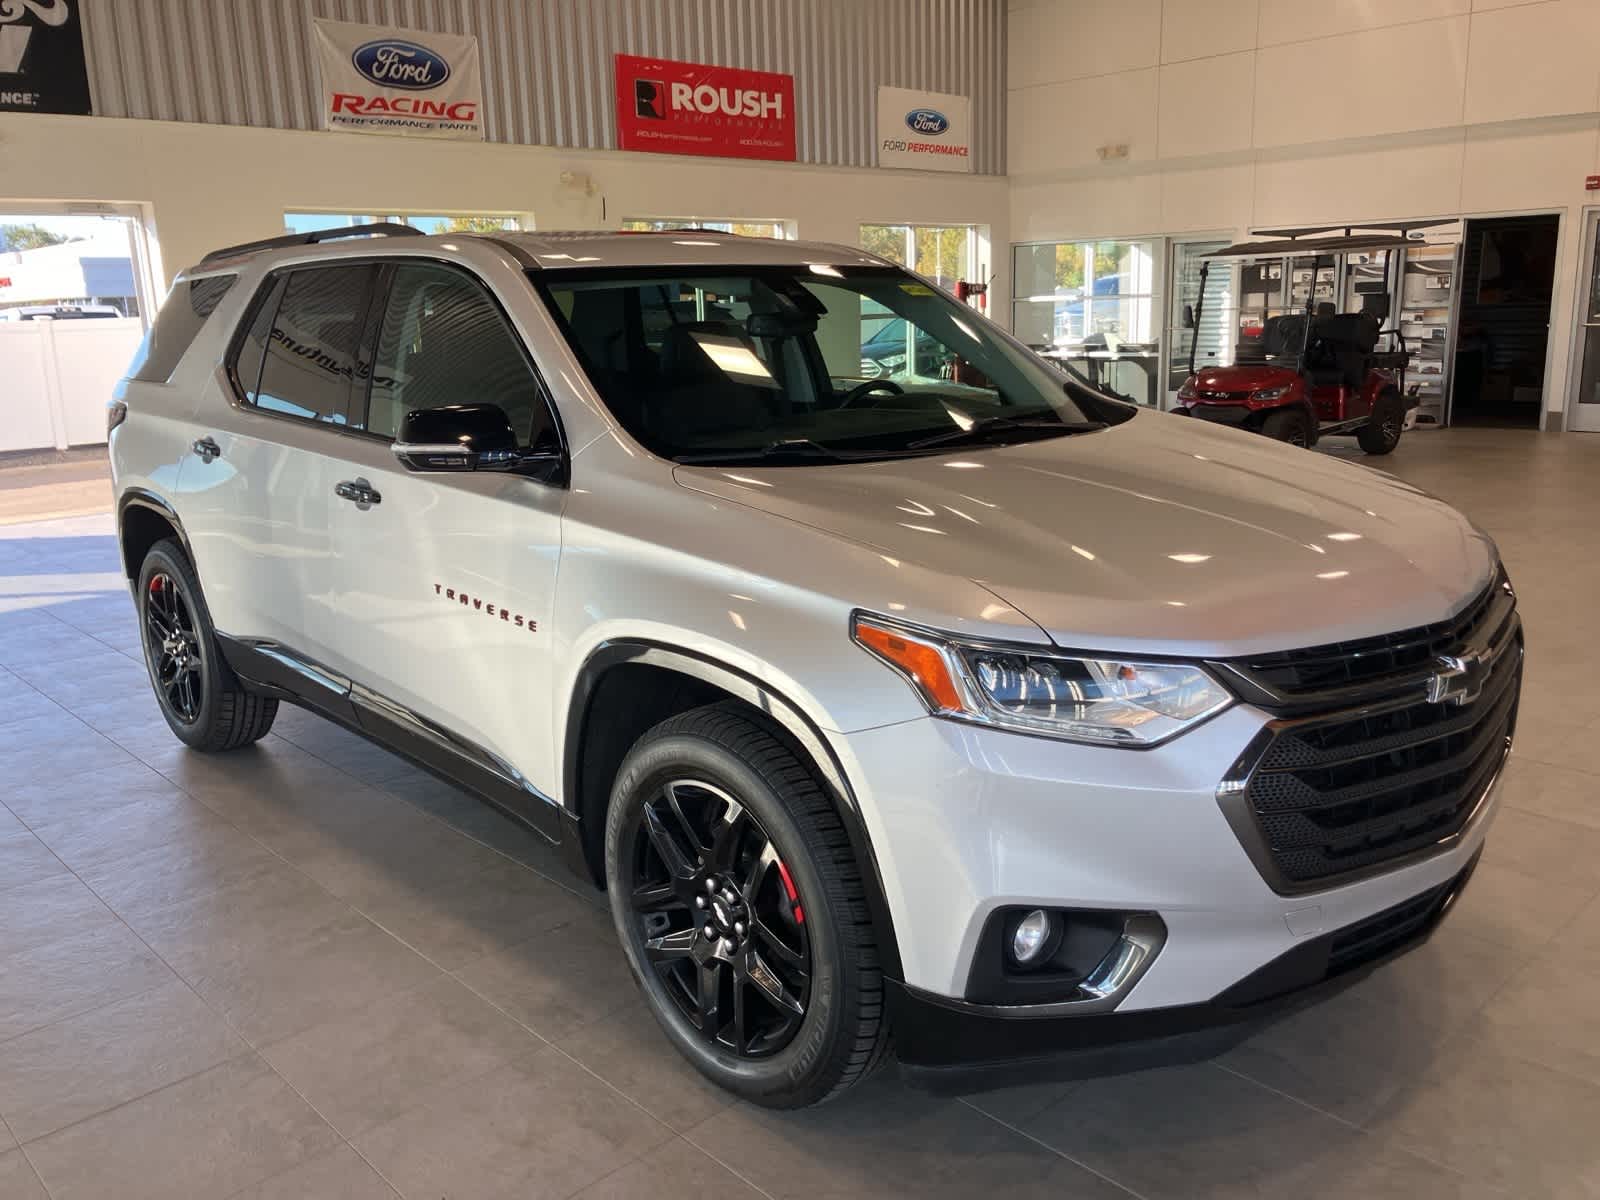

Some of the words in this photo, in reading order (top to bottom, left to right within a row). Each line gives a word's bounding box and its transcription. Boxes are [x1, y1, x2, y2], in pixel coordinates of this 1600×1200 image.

[372, 46, 432, 83] Ford
[331, 93, 476, 121] RACING
[671, 82, 782, 119] ROUSH
[332, 115, 434, 129] PERFORMANCE
[439, 122, 478, 131] PARTS
[914, 112, 941, 131] Ford
[883, 140, 906, 152] FORD
[907, 143, 968, 156] PERFORMANCE
[434, 583, 537, 632] TRAVERSE
